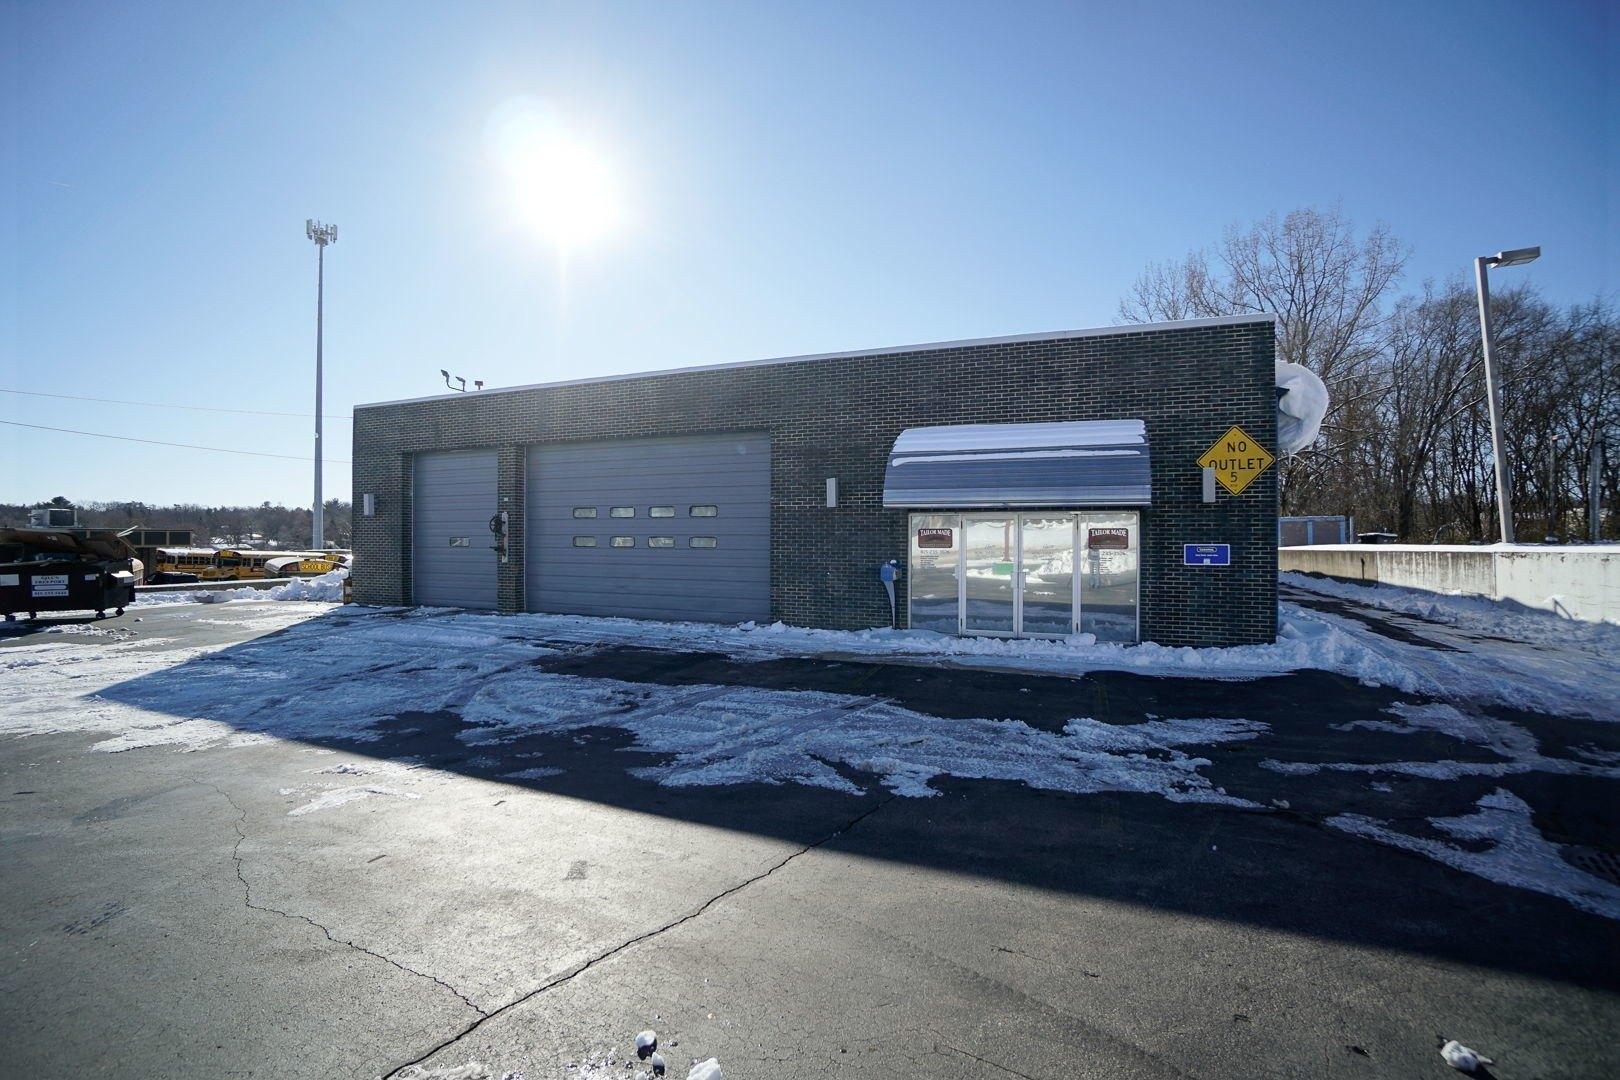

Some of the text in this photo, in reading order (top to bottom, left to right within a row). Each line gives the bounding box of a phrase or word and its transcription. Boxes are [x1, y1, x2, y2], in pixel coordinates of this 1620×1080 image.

[1227, 441, 1247, 453] NO
[1208, 458, 1264, 470] OUTLET
[1230, 471, 1238, 483] 5
[920, 529, 951, 537] TAILOR MADE
[1091, 529, 1127, 537] TAILOR MADE
[301, 563, 331, 571] SCHOOL BUS
